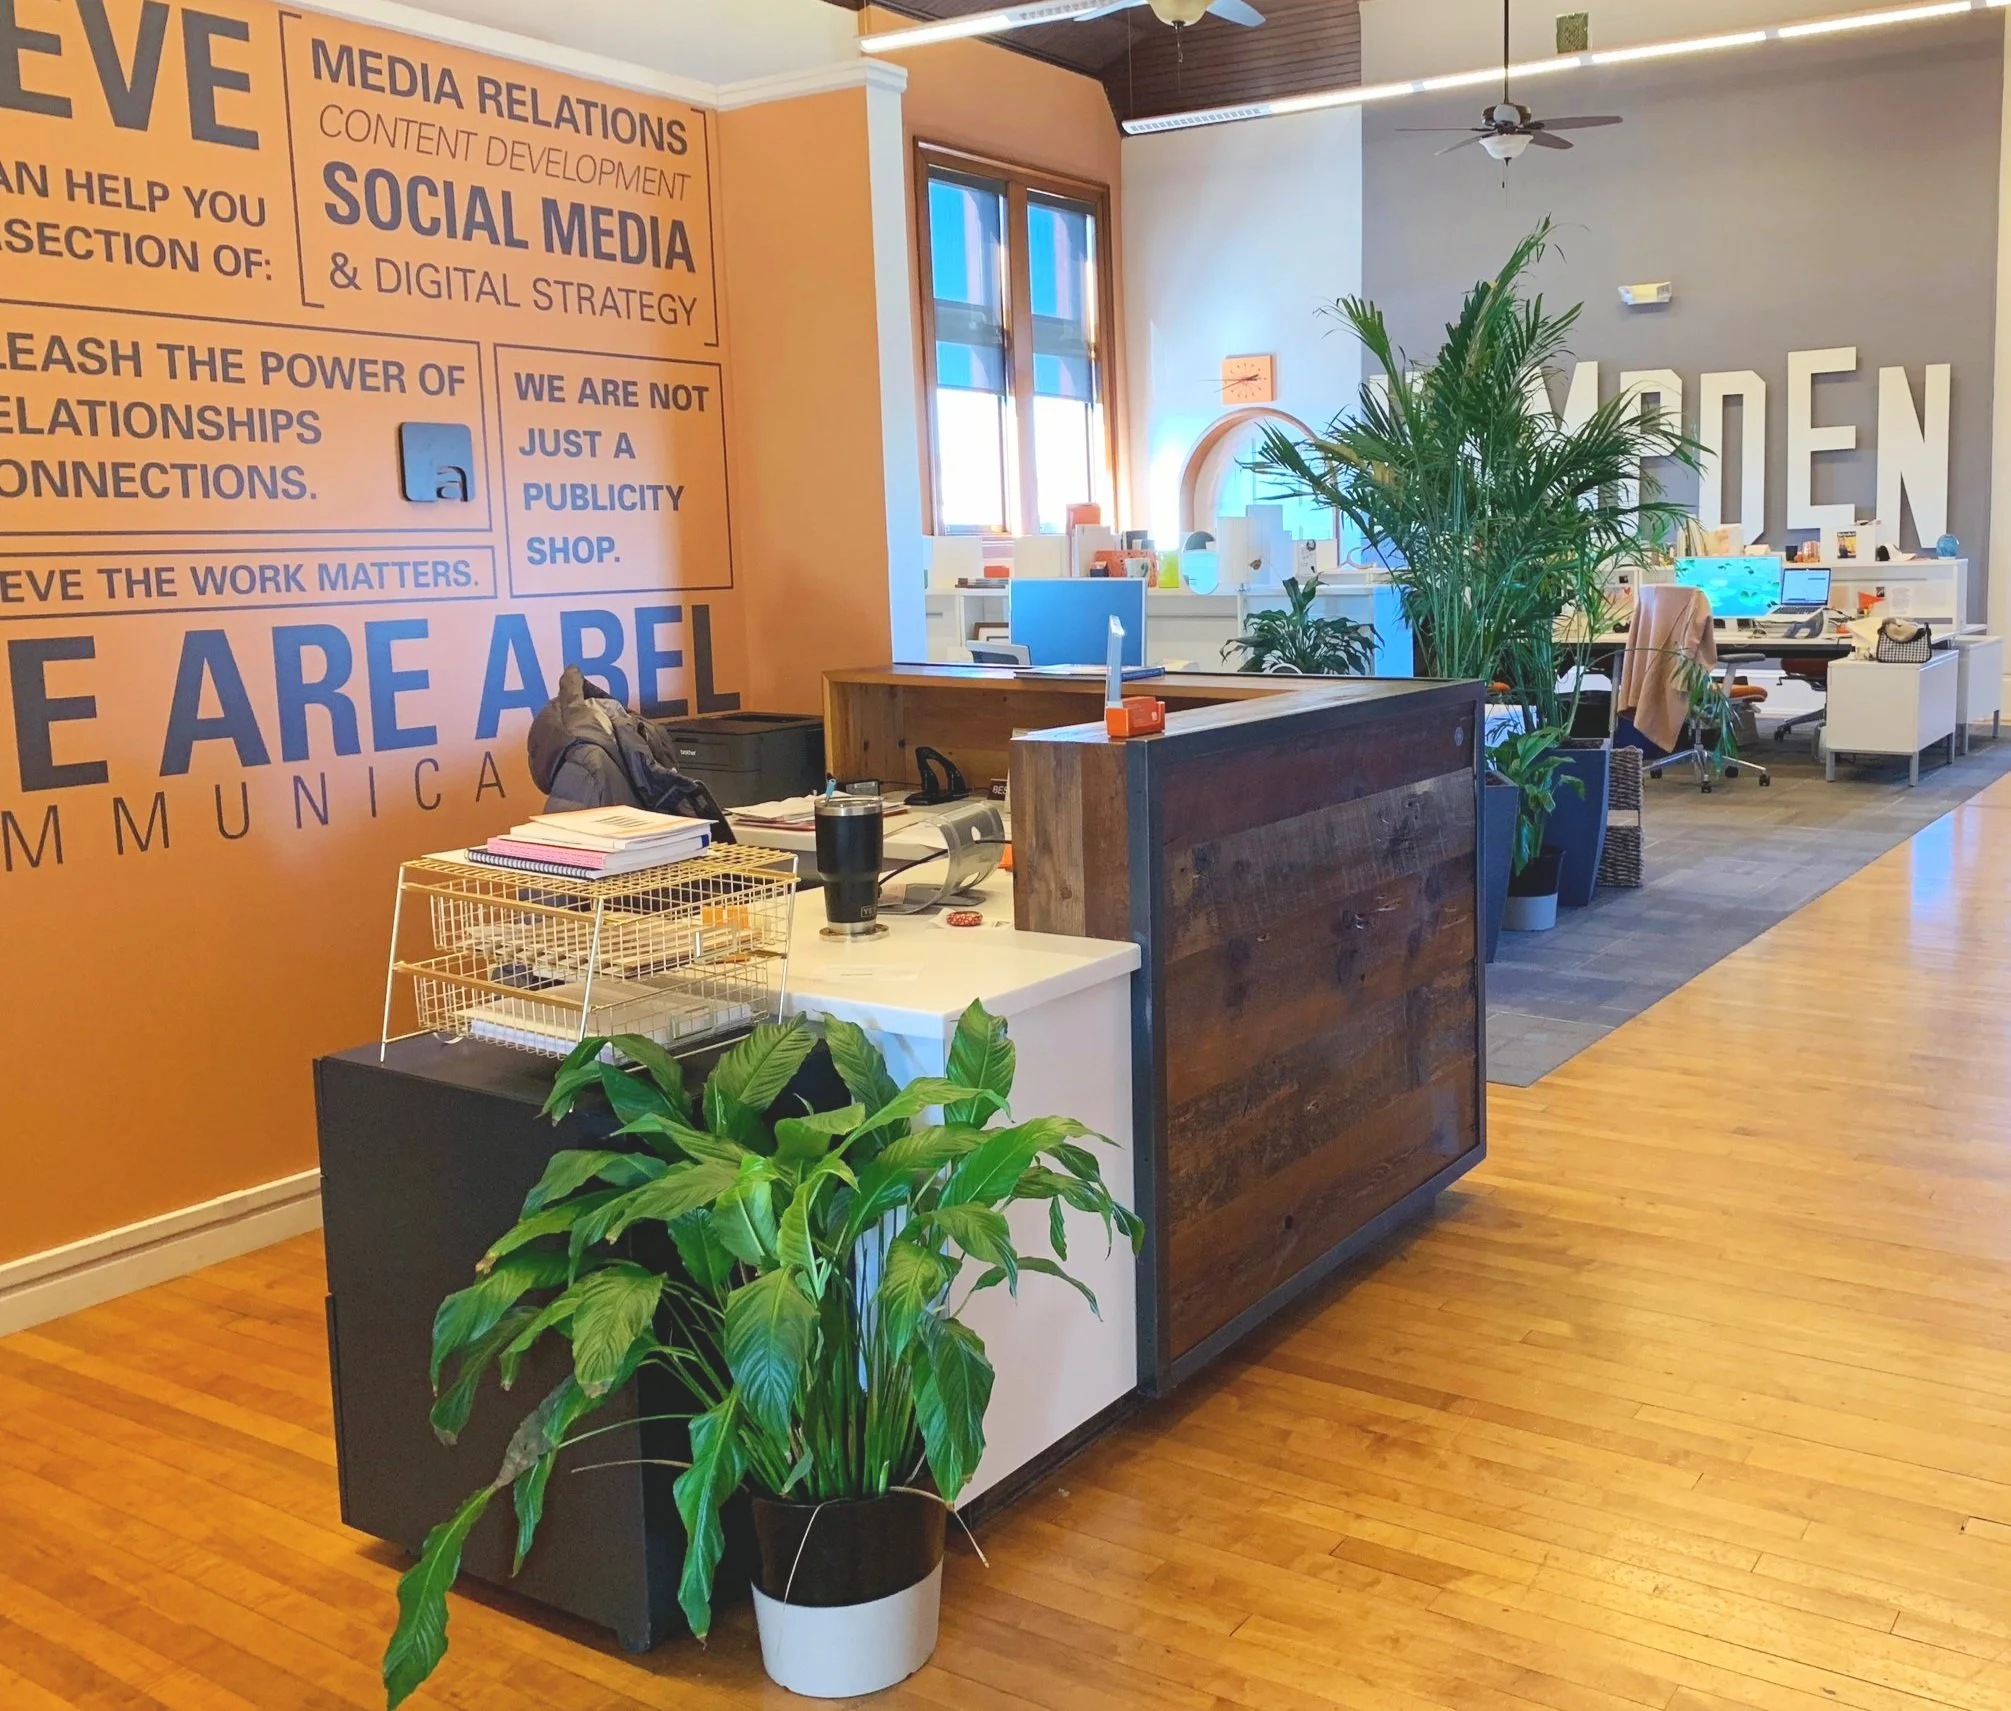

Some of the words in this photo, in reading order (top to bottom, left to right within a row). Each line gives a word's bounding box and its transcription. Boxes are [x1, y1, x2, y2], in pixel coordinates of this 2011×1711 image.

[311, 38, 464, 110] MEDIA
[478, 75, 687, 155] RELATIONS
[319, 104, 478, 162] CONTENT
[486, 136, 691, 200] DEVELOPMENT
[65, 168, 169, 212] HELP
[182, 185, 266, 227] YOU
[323, 161, 529, 250] SOCIAL
[542, 196, 696, 273] MEDIA
[0, 218, 199, 272] SECTION
[213, 244, 272, 280] OF:
[329, 252, 362, 290] &
[375, 257, 520, 307] DIGITAL
[532, 277, 697, 326] STRATEGY
[0, 332, 142, 377] EASH
[156, 343, 245, 384] THE
[261, 351, 406, 393] POWER
[418, 363, 466, 396] OF
[514, 372, 566, 403] WE
[578, 377, 639, 407] ARE
[650, 382, 709, 412] NOT
[519, 428, 602, 458] JUST
[613, 432, 636, 459] A
[0, 459, 317, 499] ONNECTIONS.
[523, 482, 684, 511] PUBLICITY
[527, 536, 621, 565] SHOP.
[0, 569, 84, 603] EVE
[97, 567, 178, 599] THE
[190, 564, 306, 595] WORK
[318, 560, 479, 592] MATTERS.
[7, 635, 109, 793] E
[159, 618, 438, 777] ARE
[475, 604, 741, 741] ABEL
